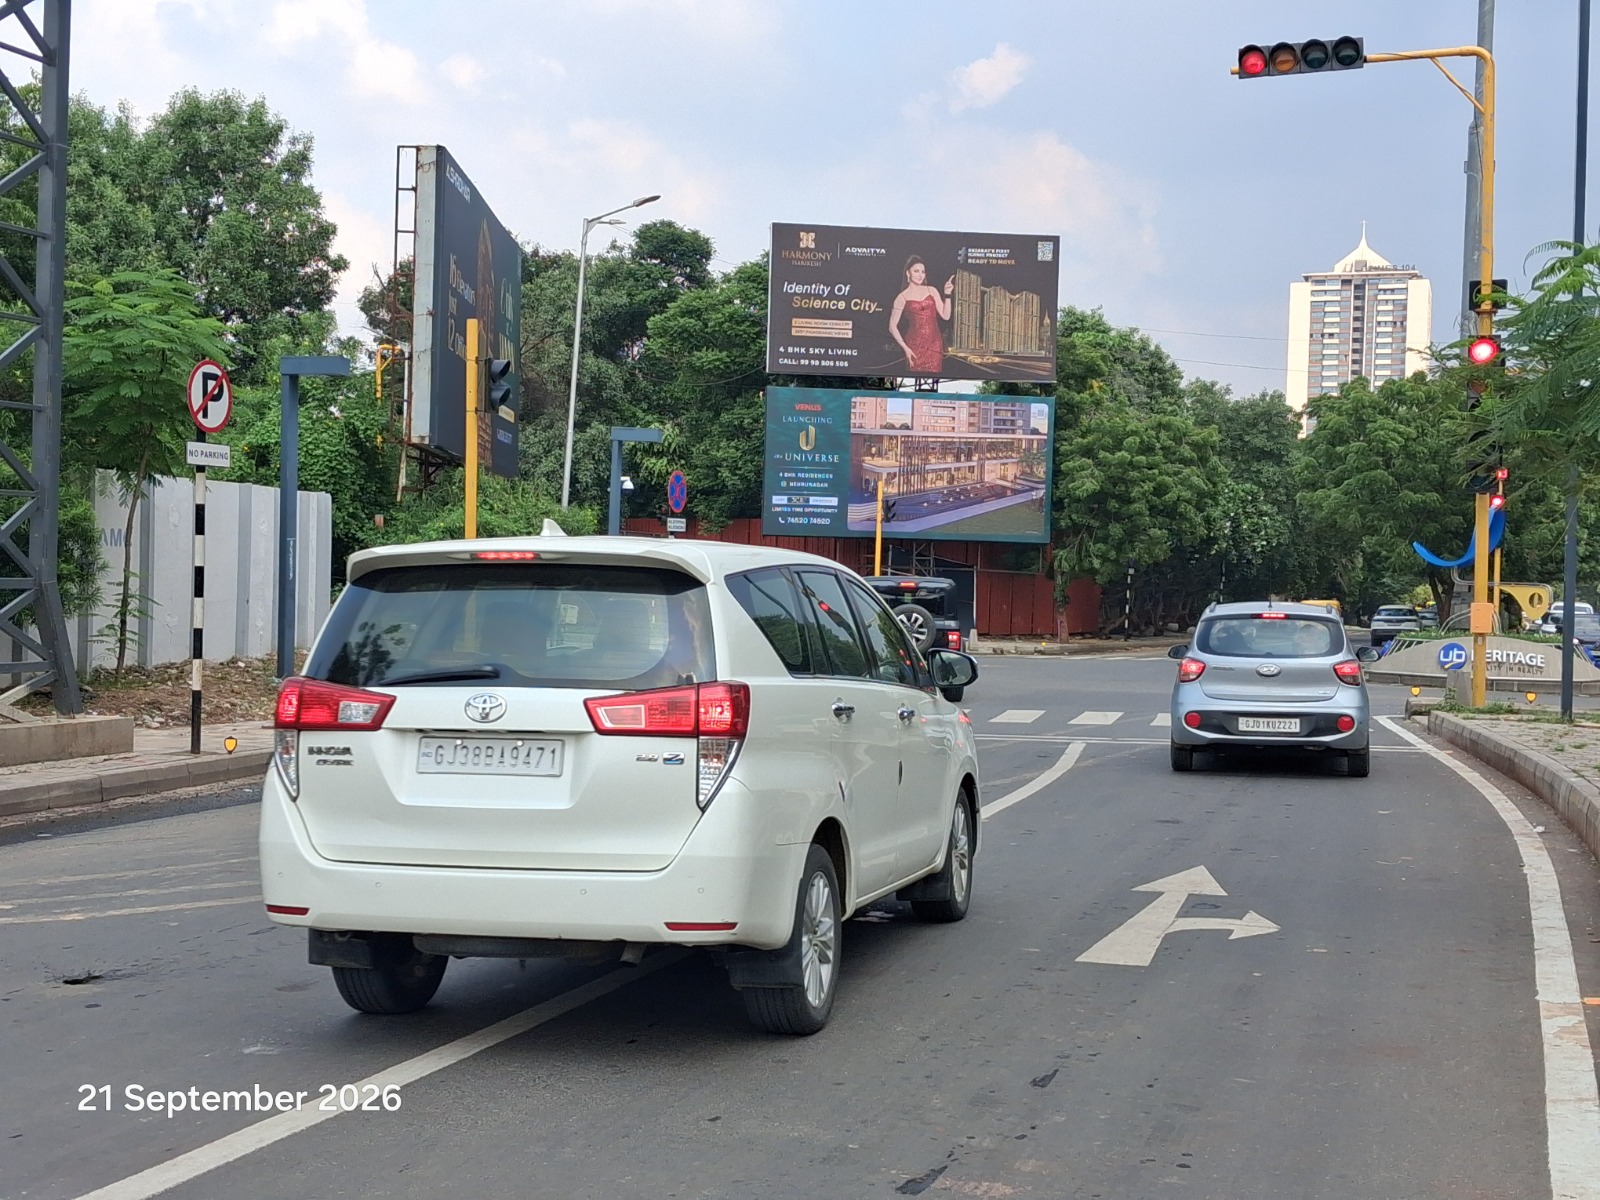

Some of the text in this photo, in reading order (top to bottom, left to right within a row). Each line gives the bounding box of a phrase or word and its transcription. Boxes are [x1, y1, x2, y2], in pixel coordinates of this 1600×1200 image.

[781, 250, 832, 261] HARMONY
[783, 281, 851, 297] Identity Of
[792, 296, 846, 310] Science
[788, 346, 806, 354] BHK
[809, 347, 826, 355] SKY
[828, 348, 858, 356] LIVING
[202, 371, 224, 419] P
[795, 403, 822, 411] VENUS
[782, 416, 833, 424] LAUNCHING
[189, 449, 229, 460] NO PARKING
[785, 453, 840, 463] UNIVERSE
[100, 527, 126, 547] AM
[1440, 648, 1545, 667] ub ERITAGE
[1517, 666, 1544, 676] REALTY
[1245, 720, 1297, 730] GJ01KU2221
[434, 744, 556, 769] GJ38BA9471
